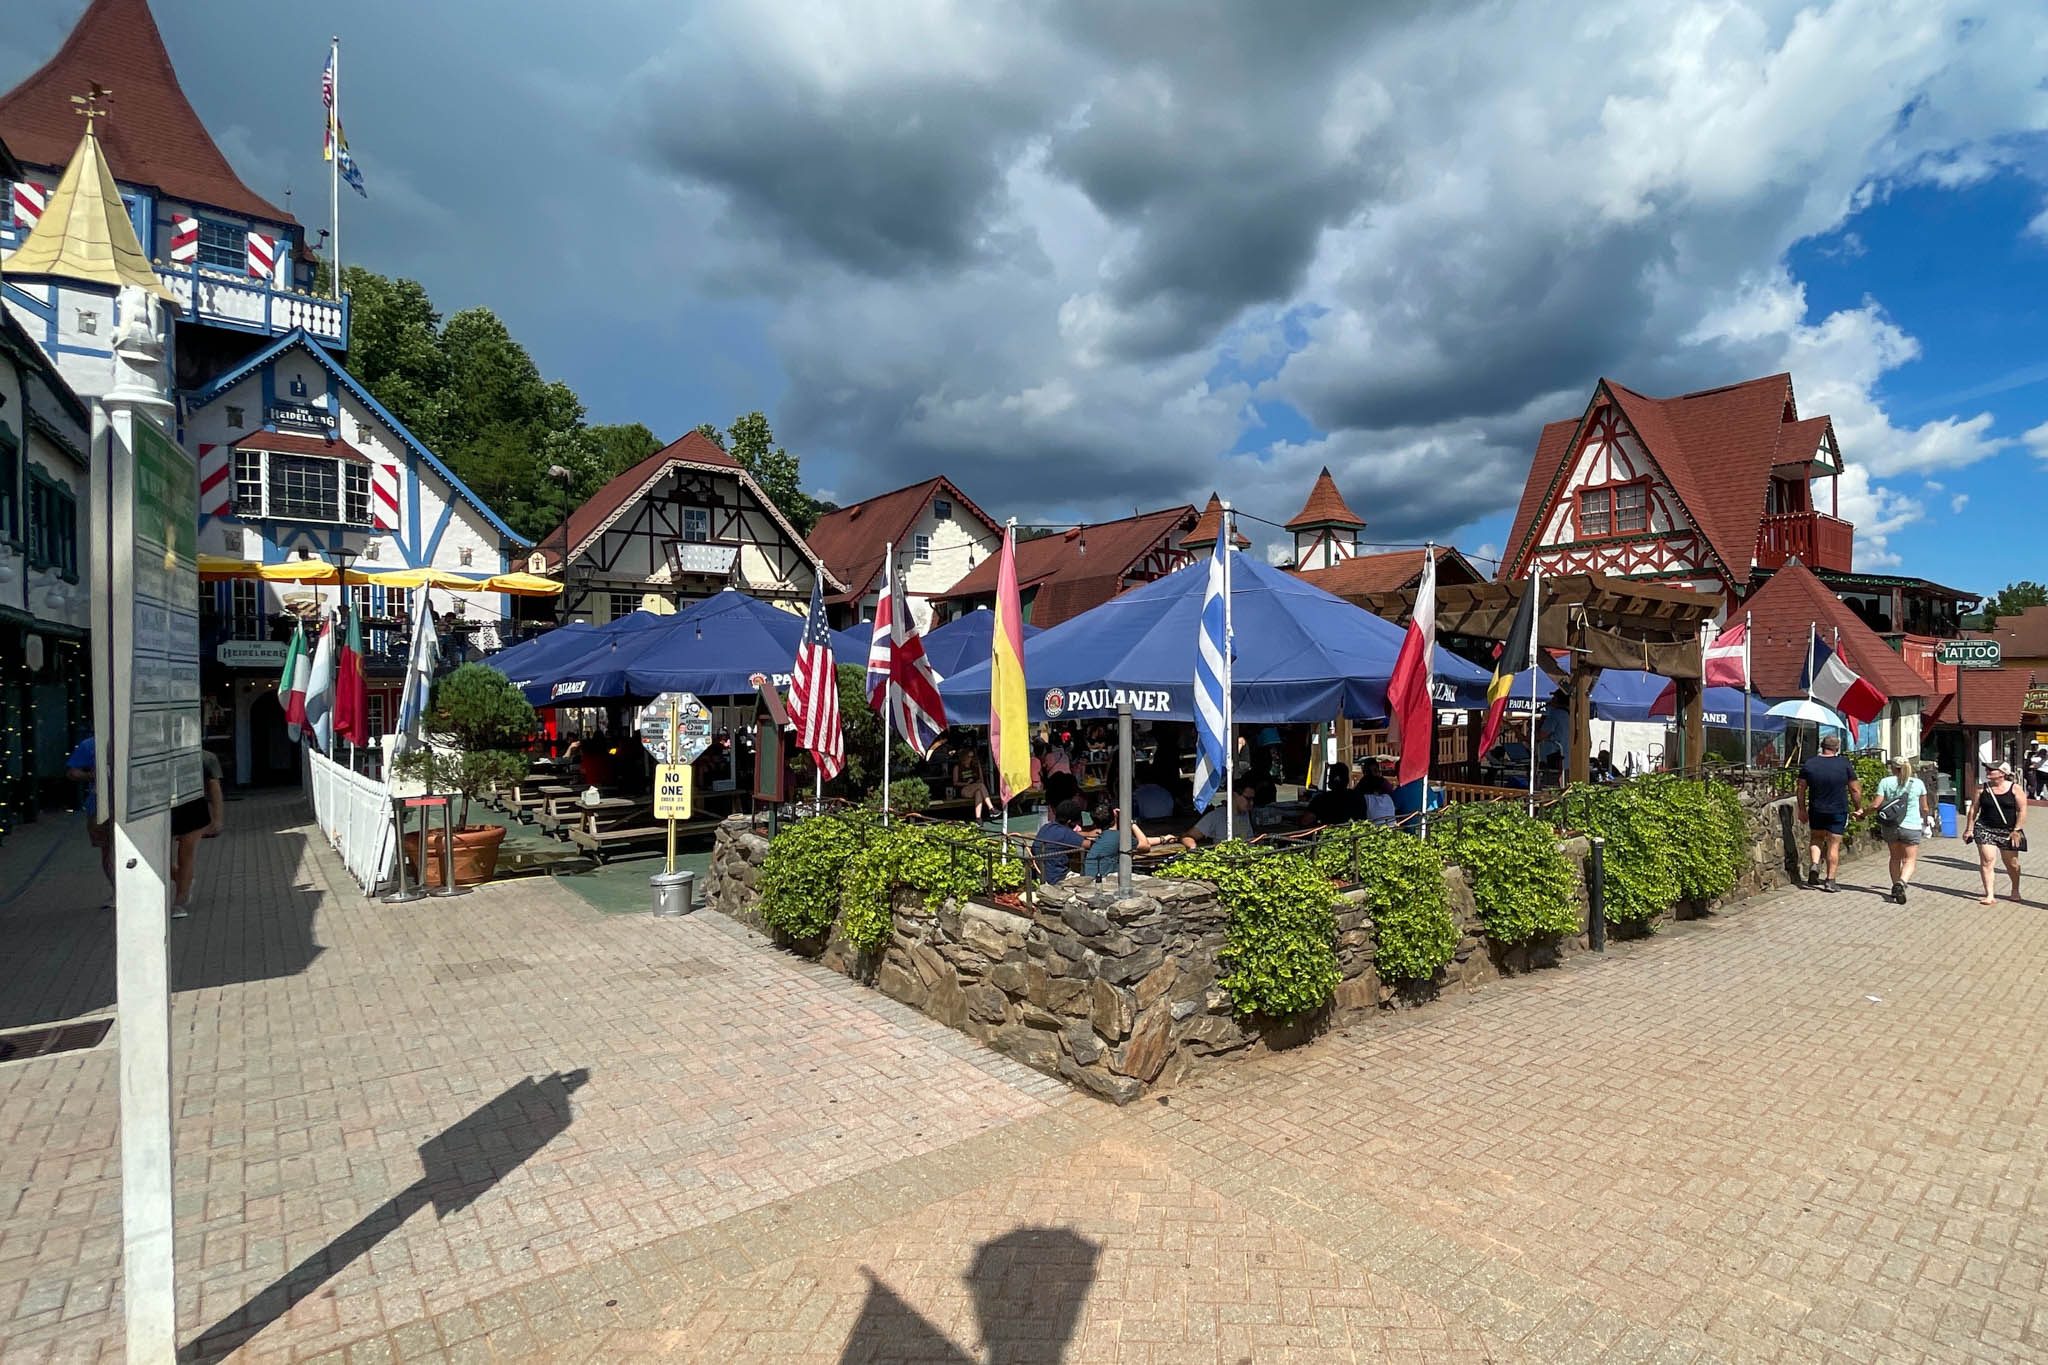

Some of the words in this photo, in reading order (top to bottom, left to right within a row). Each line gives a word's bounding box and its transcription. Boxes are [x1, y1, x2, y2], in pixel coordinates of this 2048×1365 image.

[270, 408, 335, 427] HEIDELBERG
[1944, 646, 1999, 658] TATTOO
[1067, 689, 1170, 711] PAULANER
[665, 772, 680, 783] NO
[661, 785, 684, 796] ONE
